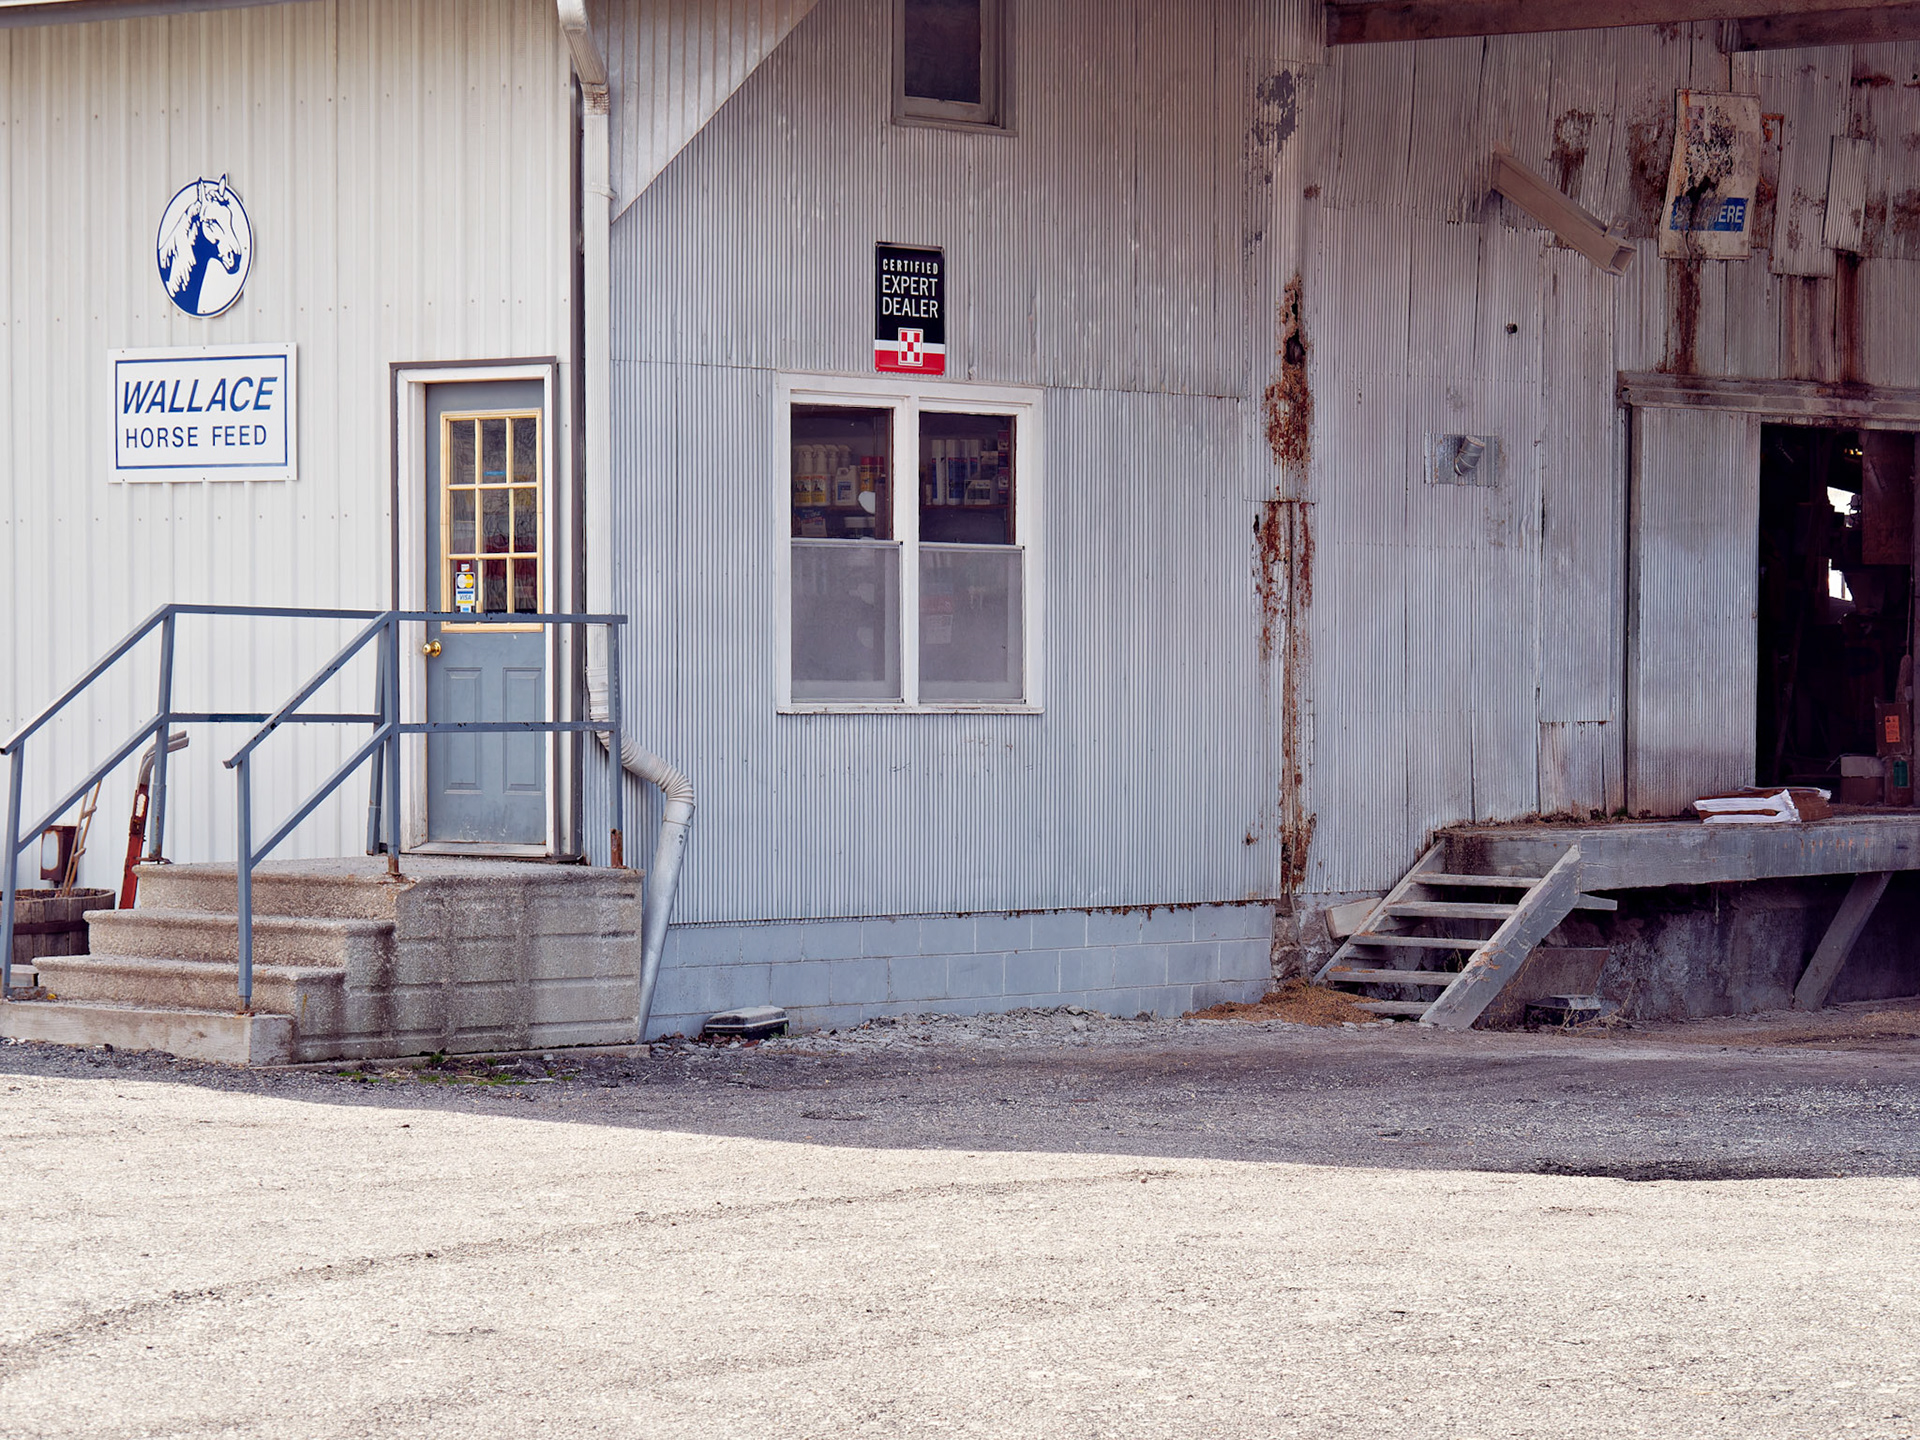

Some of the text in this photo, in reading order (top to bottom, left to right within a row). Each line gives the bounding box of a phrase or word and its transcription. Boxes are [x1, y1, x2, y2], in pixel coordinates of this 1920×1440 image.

[1714, 204, 1745, 223] ERE
[882, 258, 939, 275] CERTIFIED
[882, 274, 938, 297] EXPERT
[882, 296, 939, 319] DEALER
[123, 376, 278, 414] WALLACE
[125, 424, 267, 448] HORSE FEED
